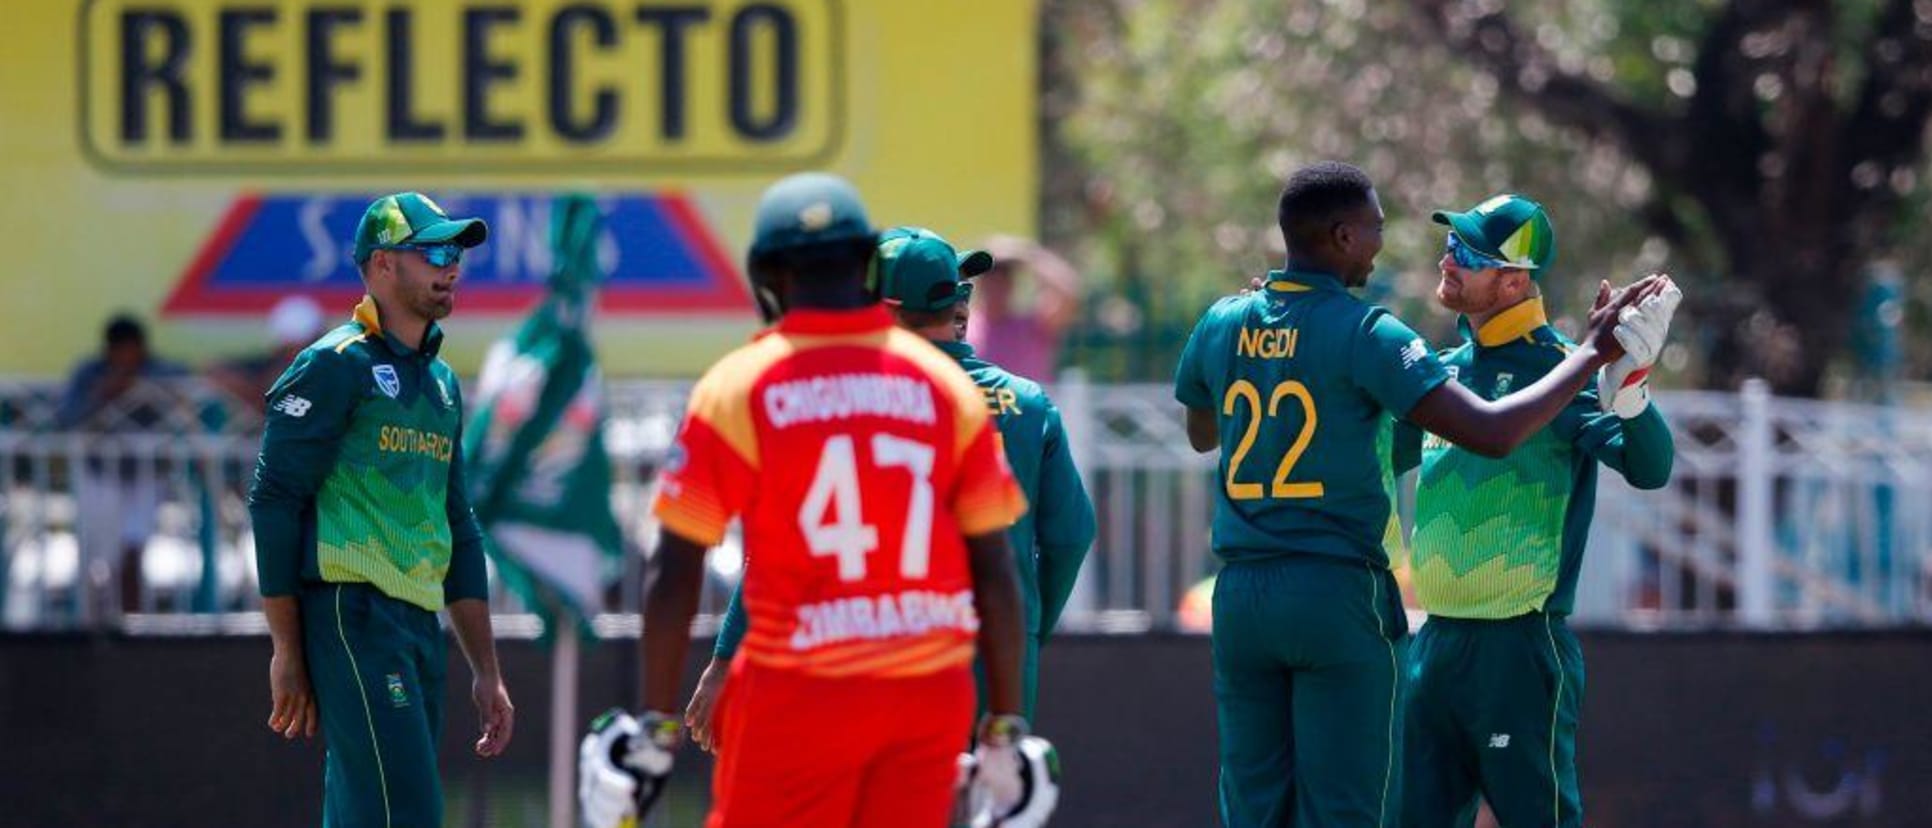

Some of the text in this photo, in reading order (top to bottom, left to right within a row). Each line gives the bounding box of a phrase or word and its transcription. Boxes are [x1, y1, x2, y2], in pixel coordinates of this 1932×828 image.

[119, 5, 799, 144] REFLECTO
[799, 433, 936, 583] 47
[1223, 379, 1324, 499] 22
